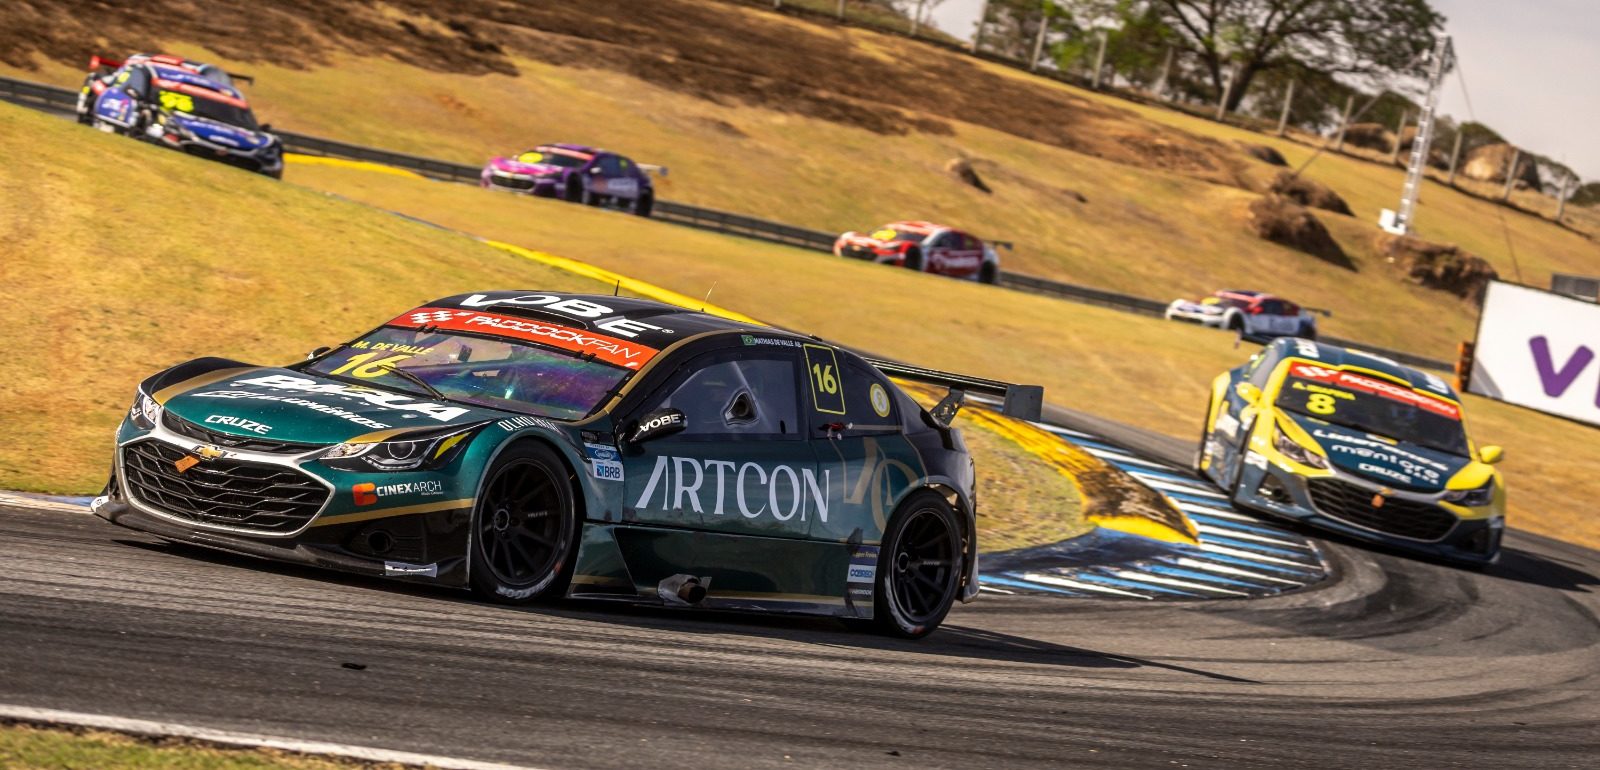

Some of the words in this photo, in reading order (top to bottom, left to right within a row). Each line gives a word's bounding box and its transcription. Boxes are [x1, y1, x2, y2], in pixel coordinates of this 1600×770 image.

[329, 352, 413, 378] 16
[1528, 335, 1600, 410] V
[812, 363, 838, 395] 16
[1305, 393, 1336, 415] 8
[204, 414, 273, 435] CRUZE
[604, 465, 621, 479] BRB
[376, 480, 442, 497] CINEXARCH
[635, 455, 830, 523] ARTCON
